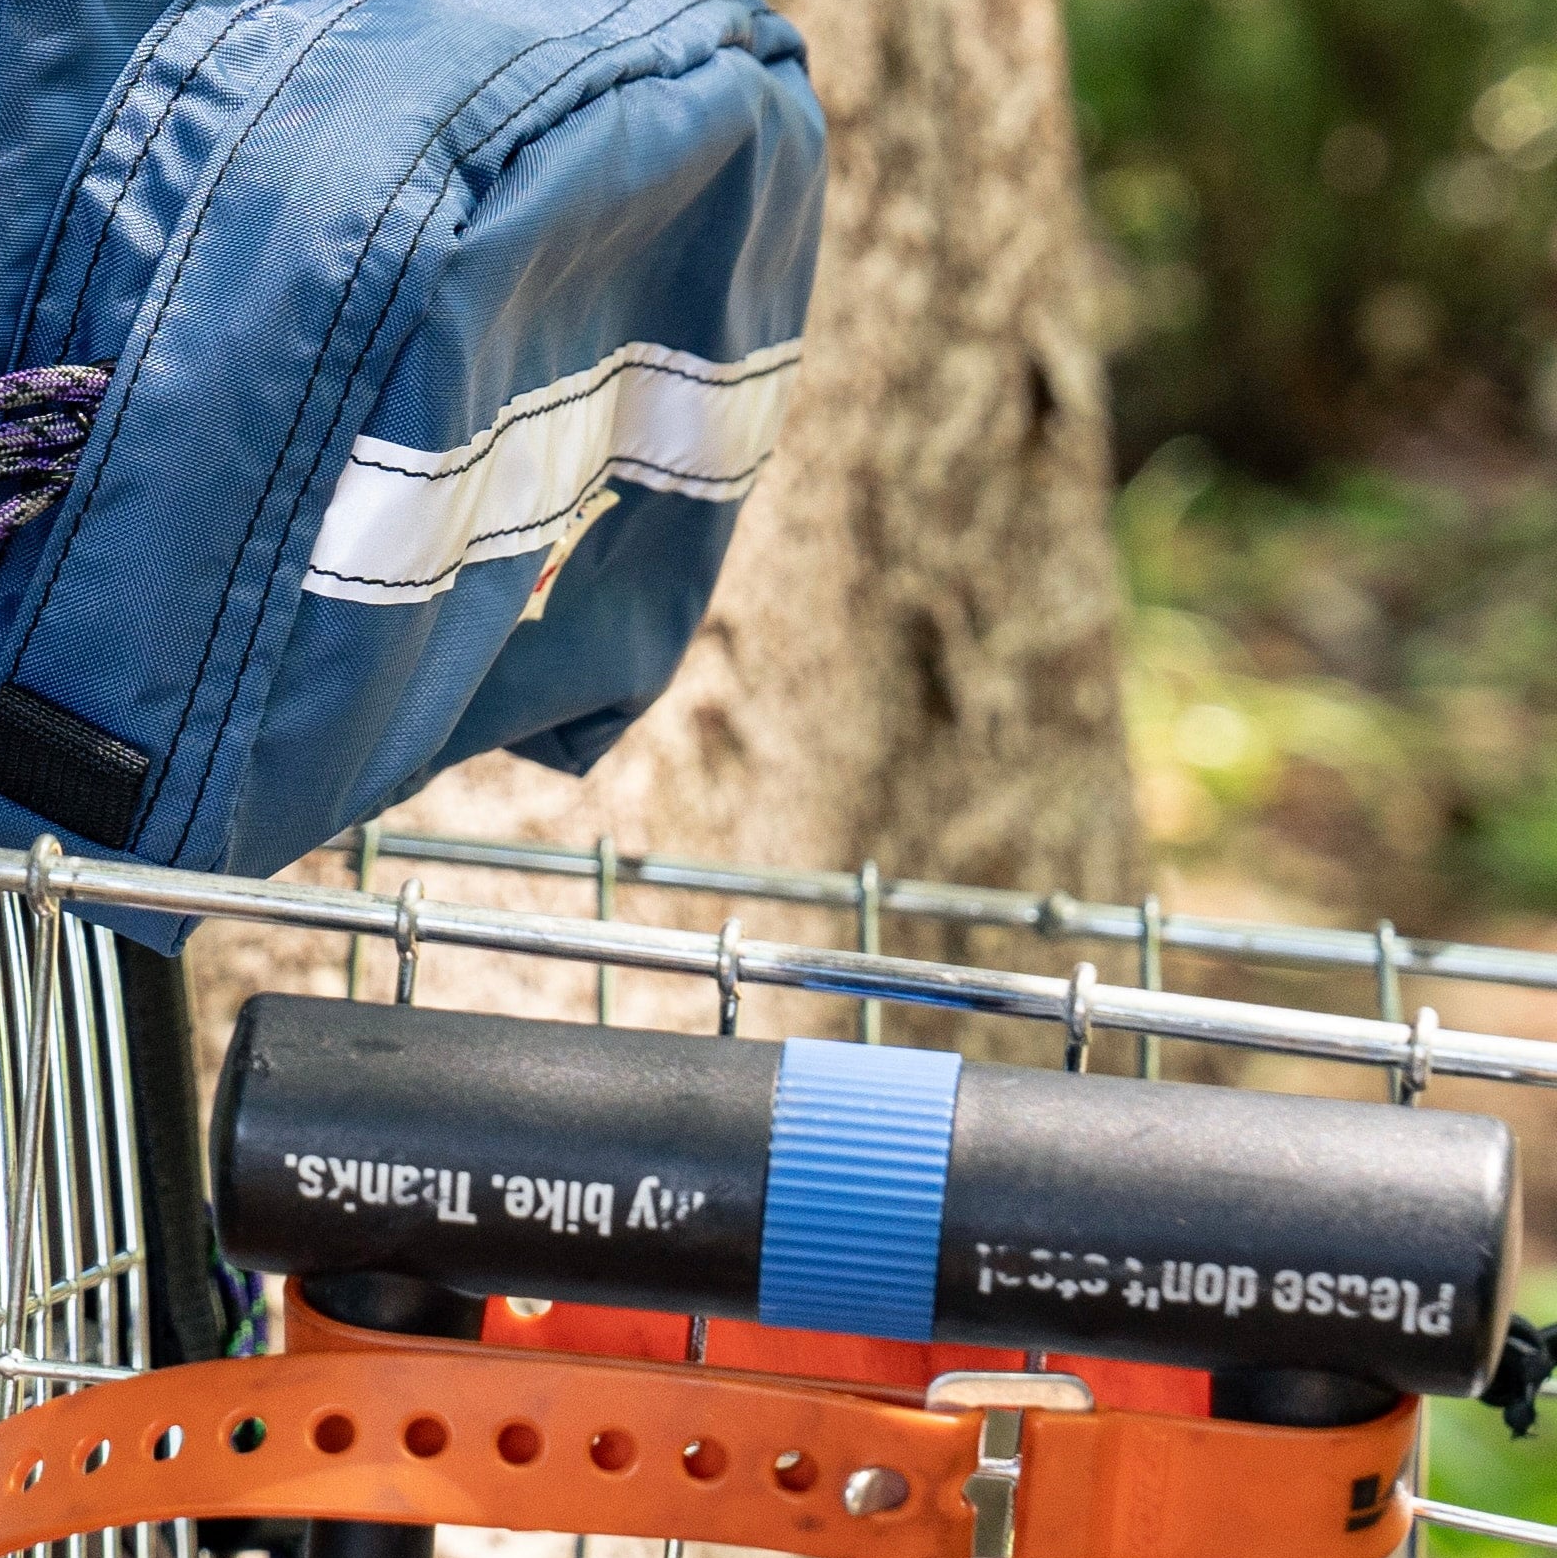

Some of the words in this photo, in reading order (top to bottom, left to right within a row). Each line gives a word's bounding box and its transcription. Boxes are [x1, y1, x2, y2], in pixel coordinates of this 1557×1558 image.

[285, 1153, 478, 1226] Thanks.
[490, 1172, 616, 1237] bike.
[1121, 1256, 1259, 1317] don't
[1271, 1268, 1456, 1337] Please
